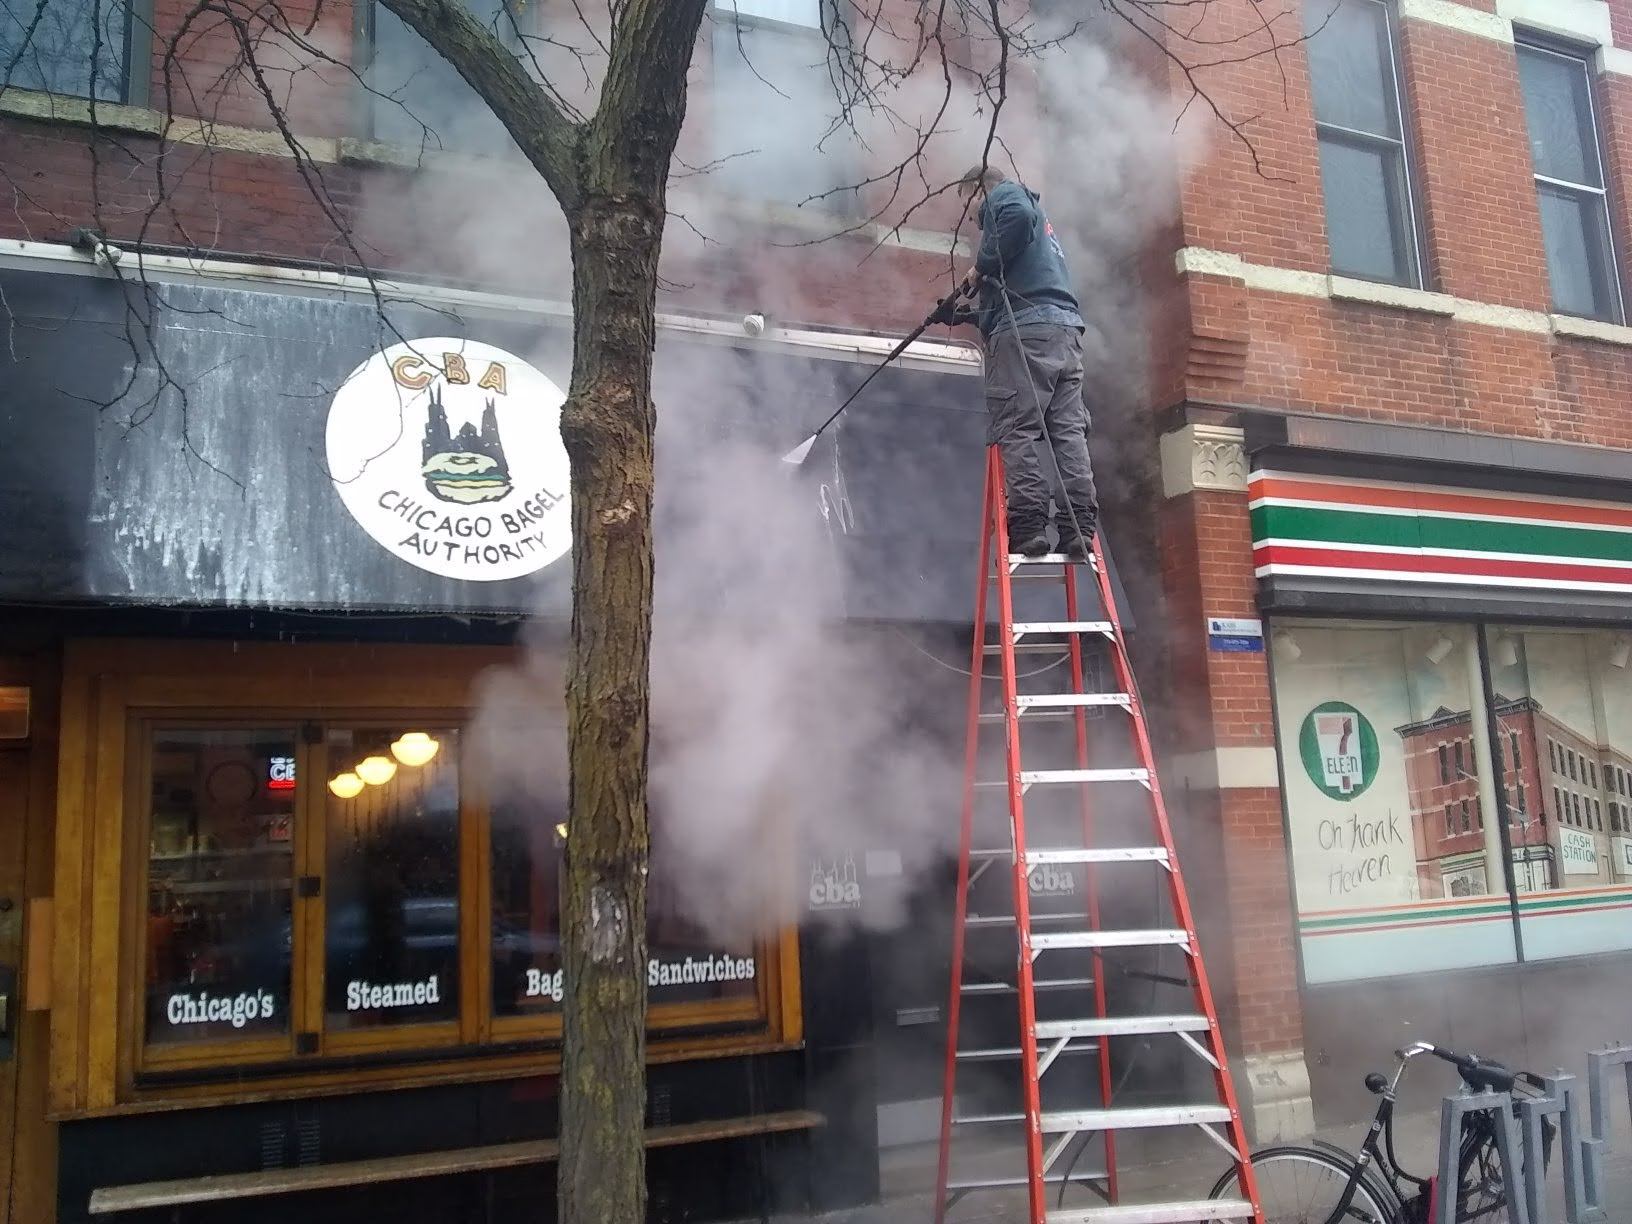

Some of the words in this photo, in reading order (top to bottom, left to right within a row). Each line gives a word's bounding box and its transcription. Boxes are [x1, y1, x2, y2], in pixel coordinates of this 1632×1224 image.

[392, 352, 507, 396] CBA
[378, 490, 491, 537] CHICAGO
[501, 488, 564, 534] BAGEL
[399, 532, 547, 564] AUTHORITY
[1563, 845, 1596, 863] STATION
[1567, 833, 1591, 848] CASH
[809, 876, 861, 904] cba
[1029, 866, 1075, 892] cba
[347, 975, 440, 1011] Steamed
[526, 968, 564, 1002] Bag
[648, 953, 755, 987] Sandwiches
[167, 989, 274, 1028] Chicago's
